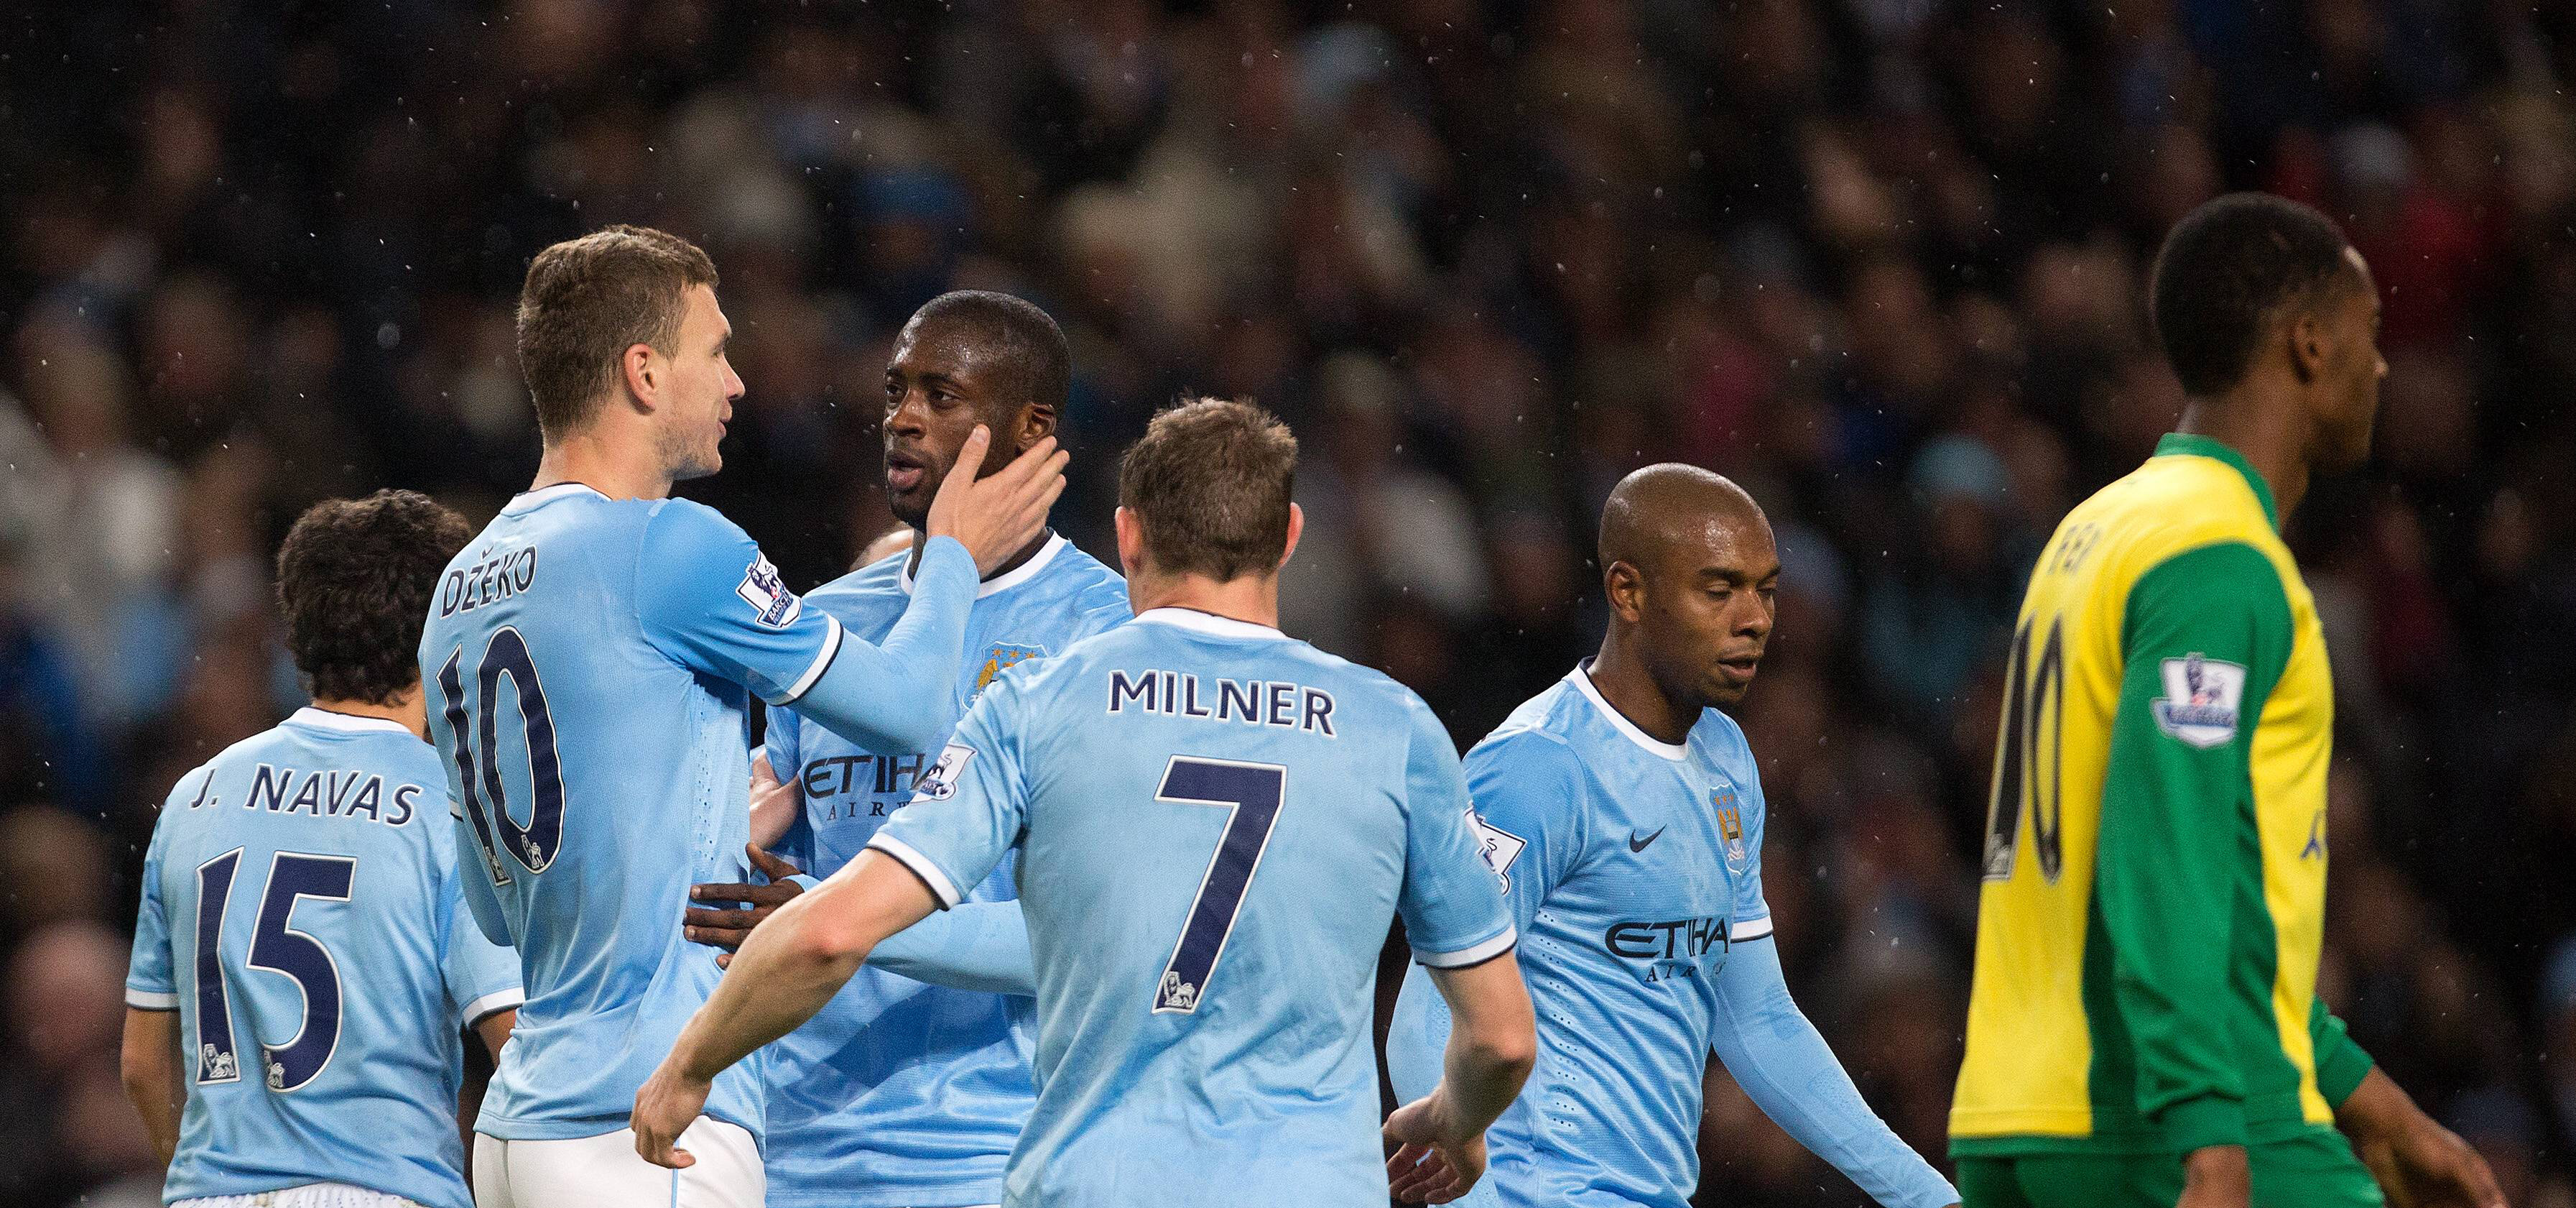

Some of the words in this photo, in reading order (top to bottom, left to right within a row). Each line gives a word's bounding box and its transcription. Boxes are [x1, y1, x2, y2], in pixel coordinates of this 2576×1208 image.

[440, 542, 537, 620] DŽEKO
[436, 624, 566, 886] 10
[1107, 669, 1337, 738] MILNER
[1982, 609, 2062, 885] 10
[190, 767, 218, 810] J.
[244, 762, 425, 827] NAVAS
[1151, 754, 1287, 1015] 7
[1605, 917, 1728, 959] ETIHA
[196, 845, 358, 1093] 15
